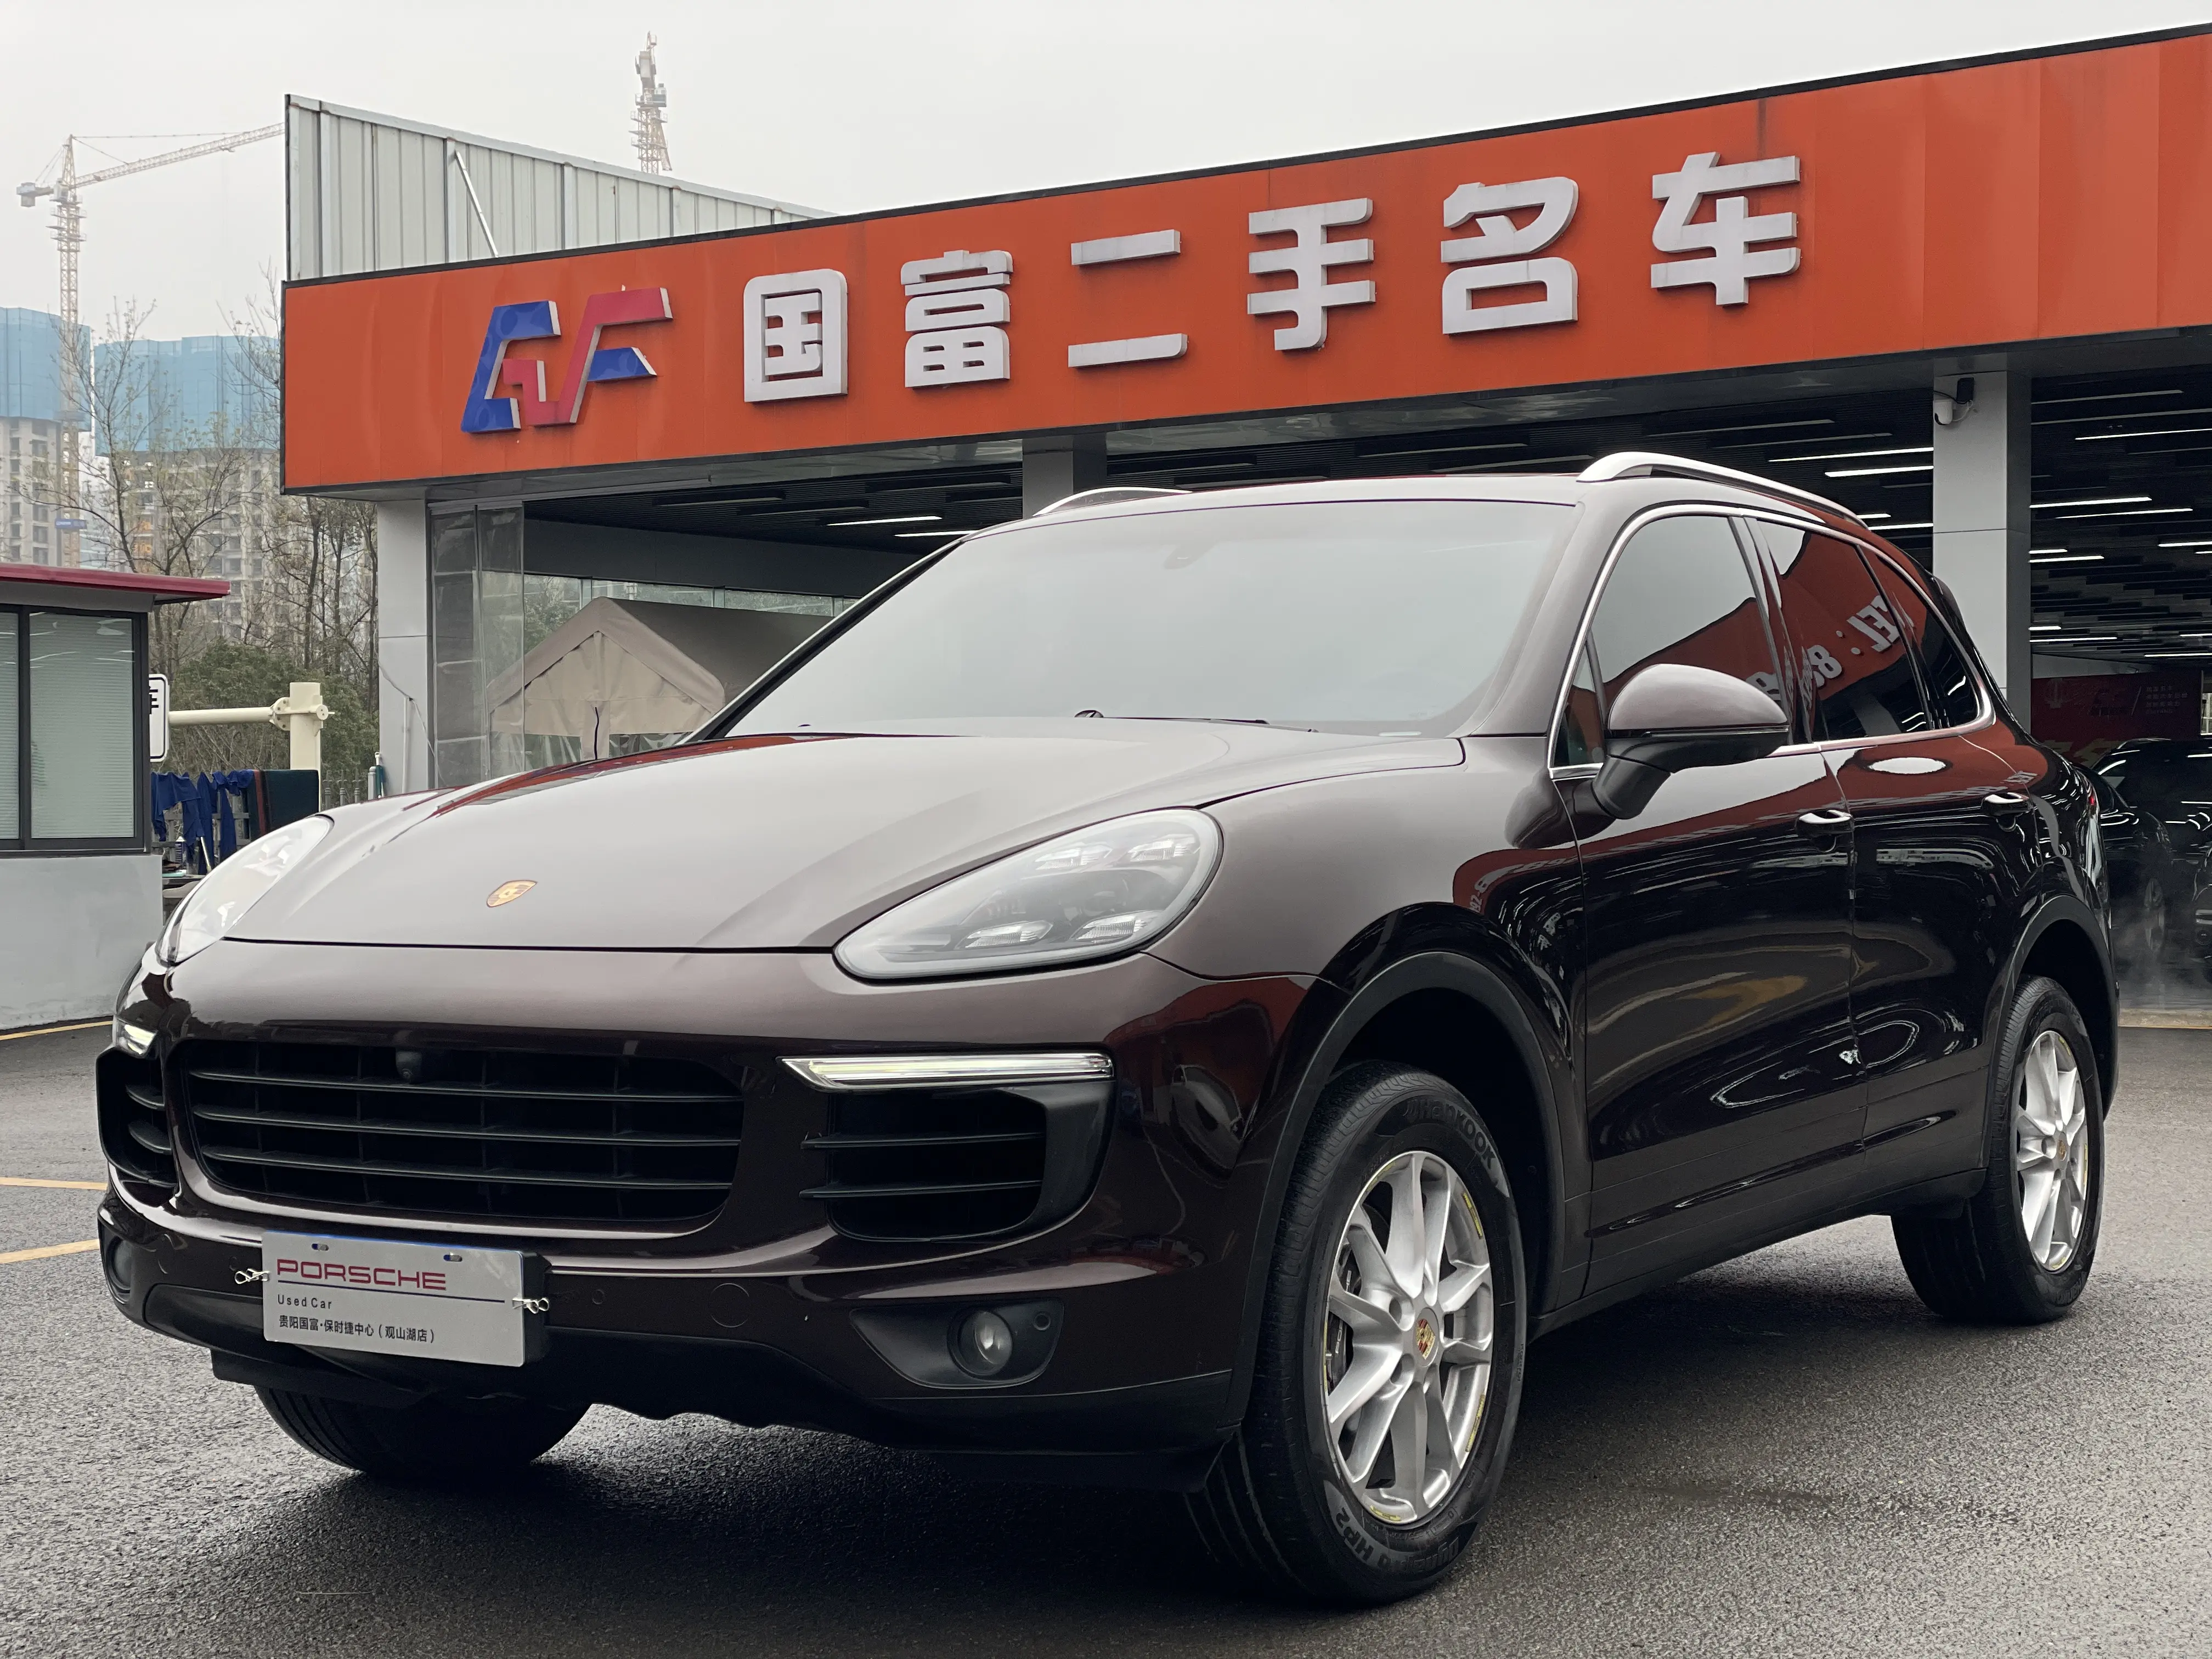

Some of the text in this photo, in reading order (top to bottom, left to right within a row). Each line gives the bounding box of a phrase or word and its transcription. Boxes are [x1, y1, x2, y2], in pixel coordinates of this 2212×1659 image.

[743, 151, 1802, 403] 国富二手名车
[276, 1259, 446, 1290] PORSCHE
[278, 1294, 332, 1310] Used Car
